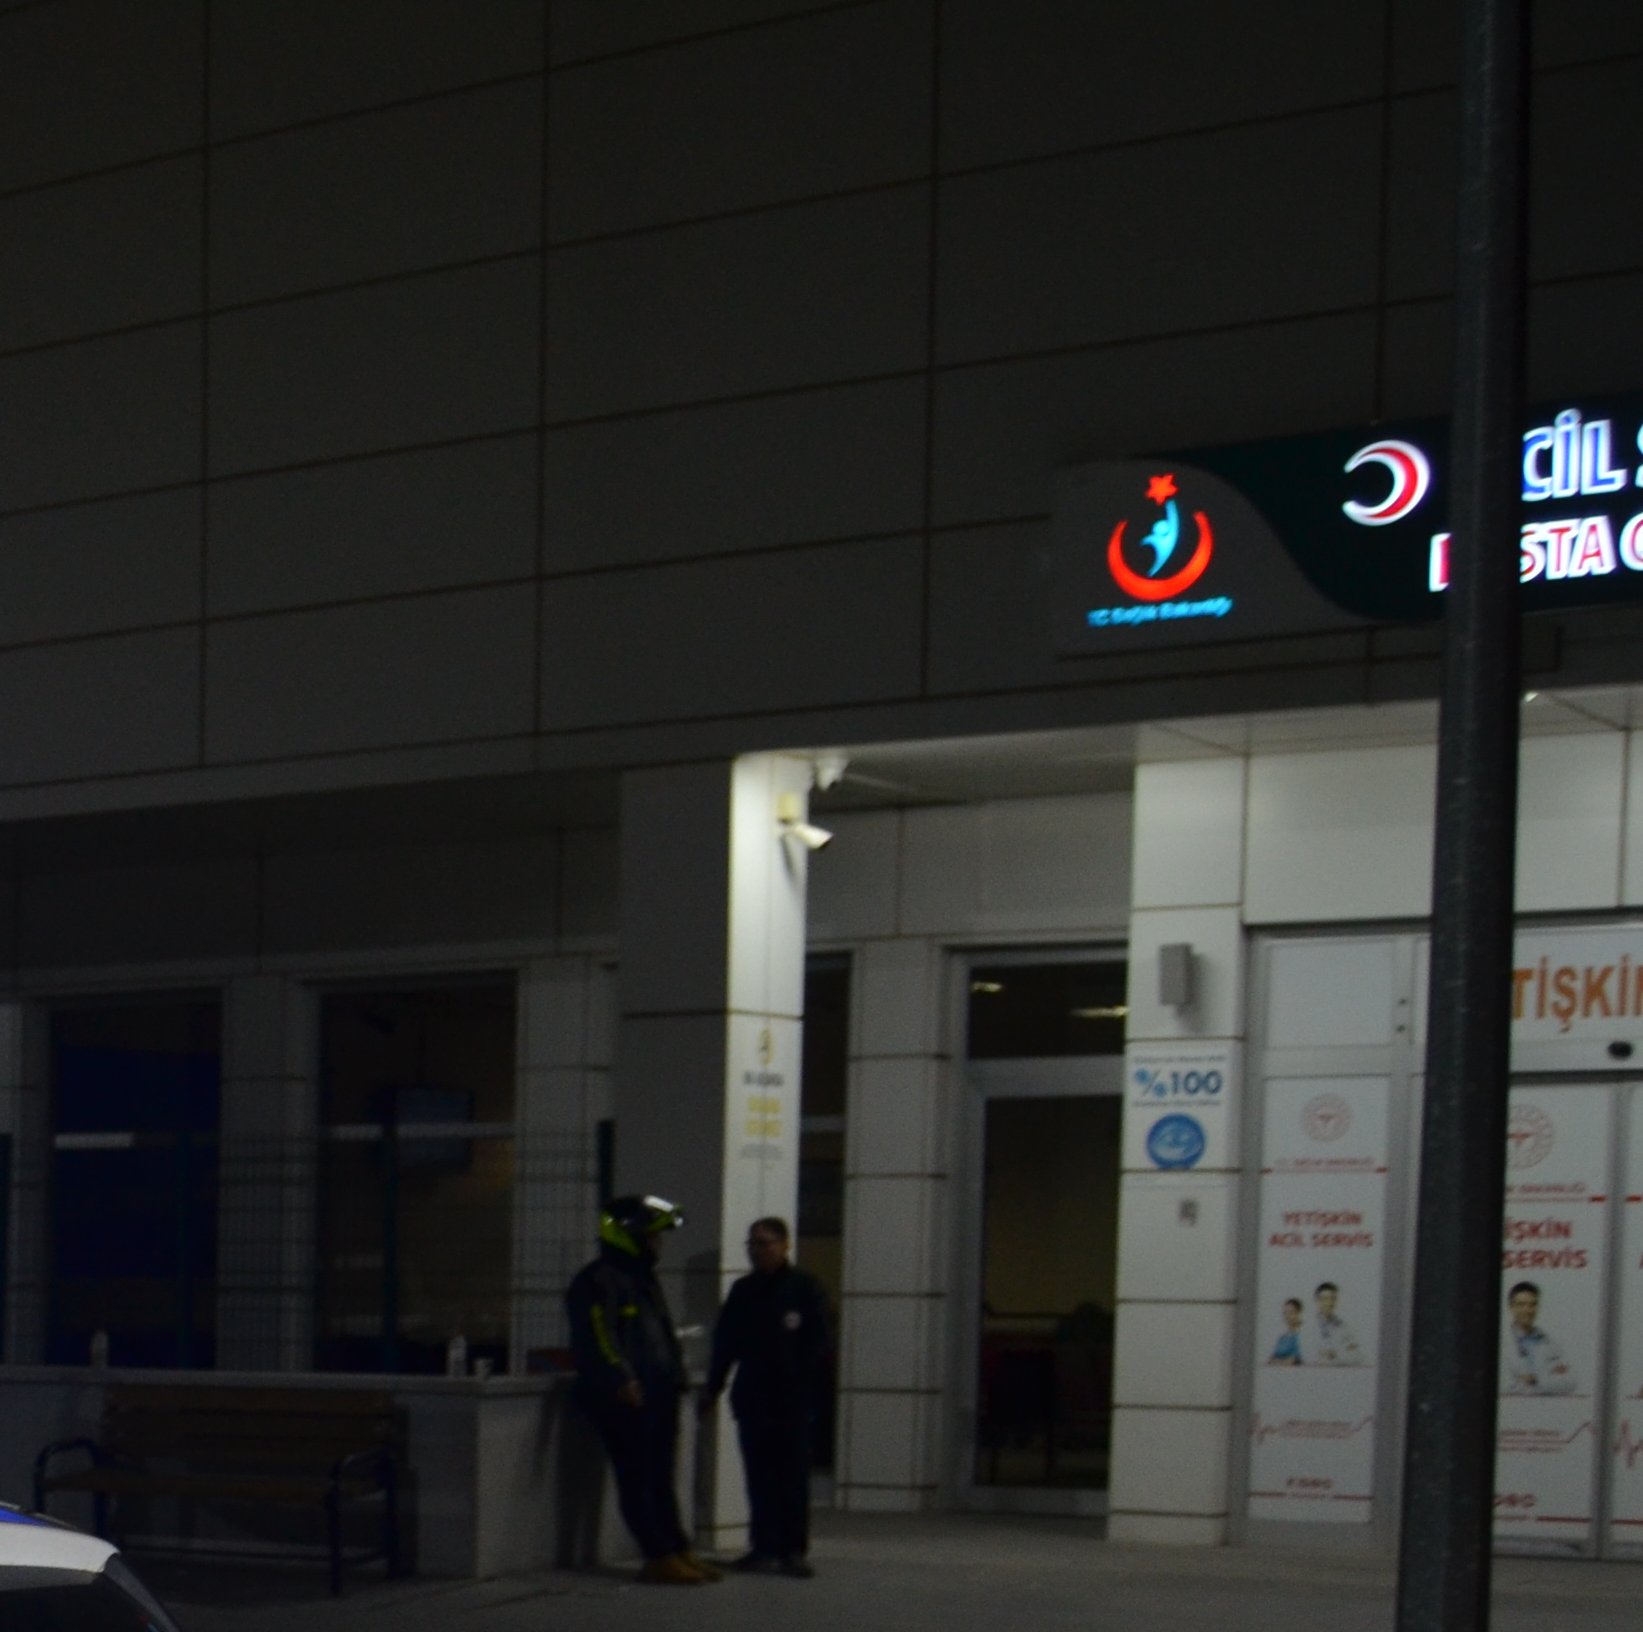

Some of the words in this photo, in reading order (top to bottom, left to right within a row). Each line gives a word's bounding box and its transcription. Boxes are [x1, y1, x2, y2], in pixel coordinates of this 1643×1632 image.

[1521, 408, 1628, 502] CİL
[1512, 954, 1643, 1034] TİŞKİ
[1504, 1216, 1571, 1244] İŞKİN
